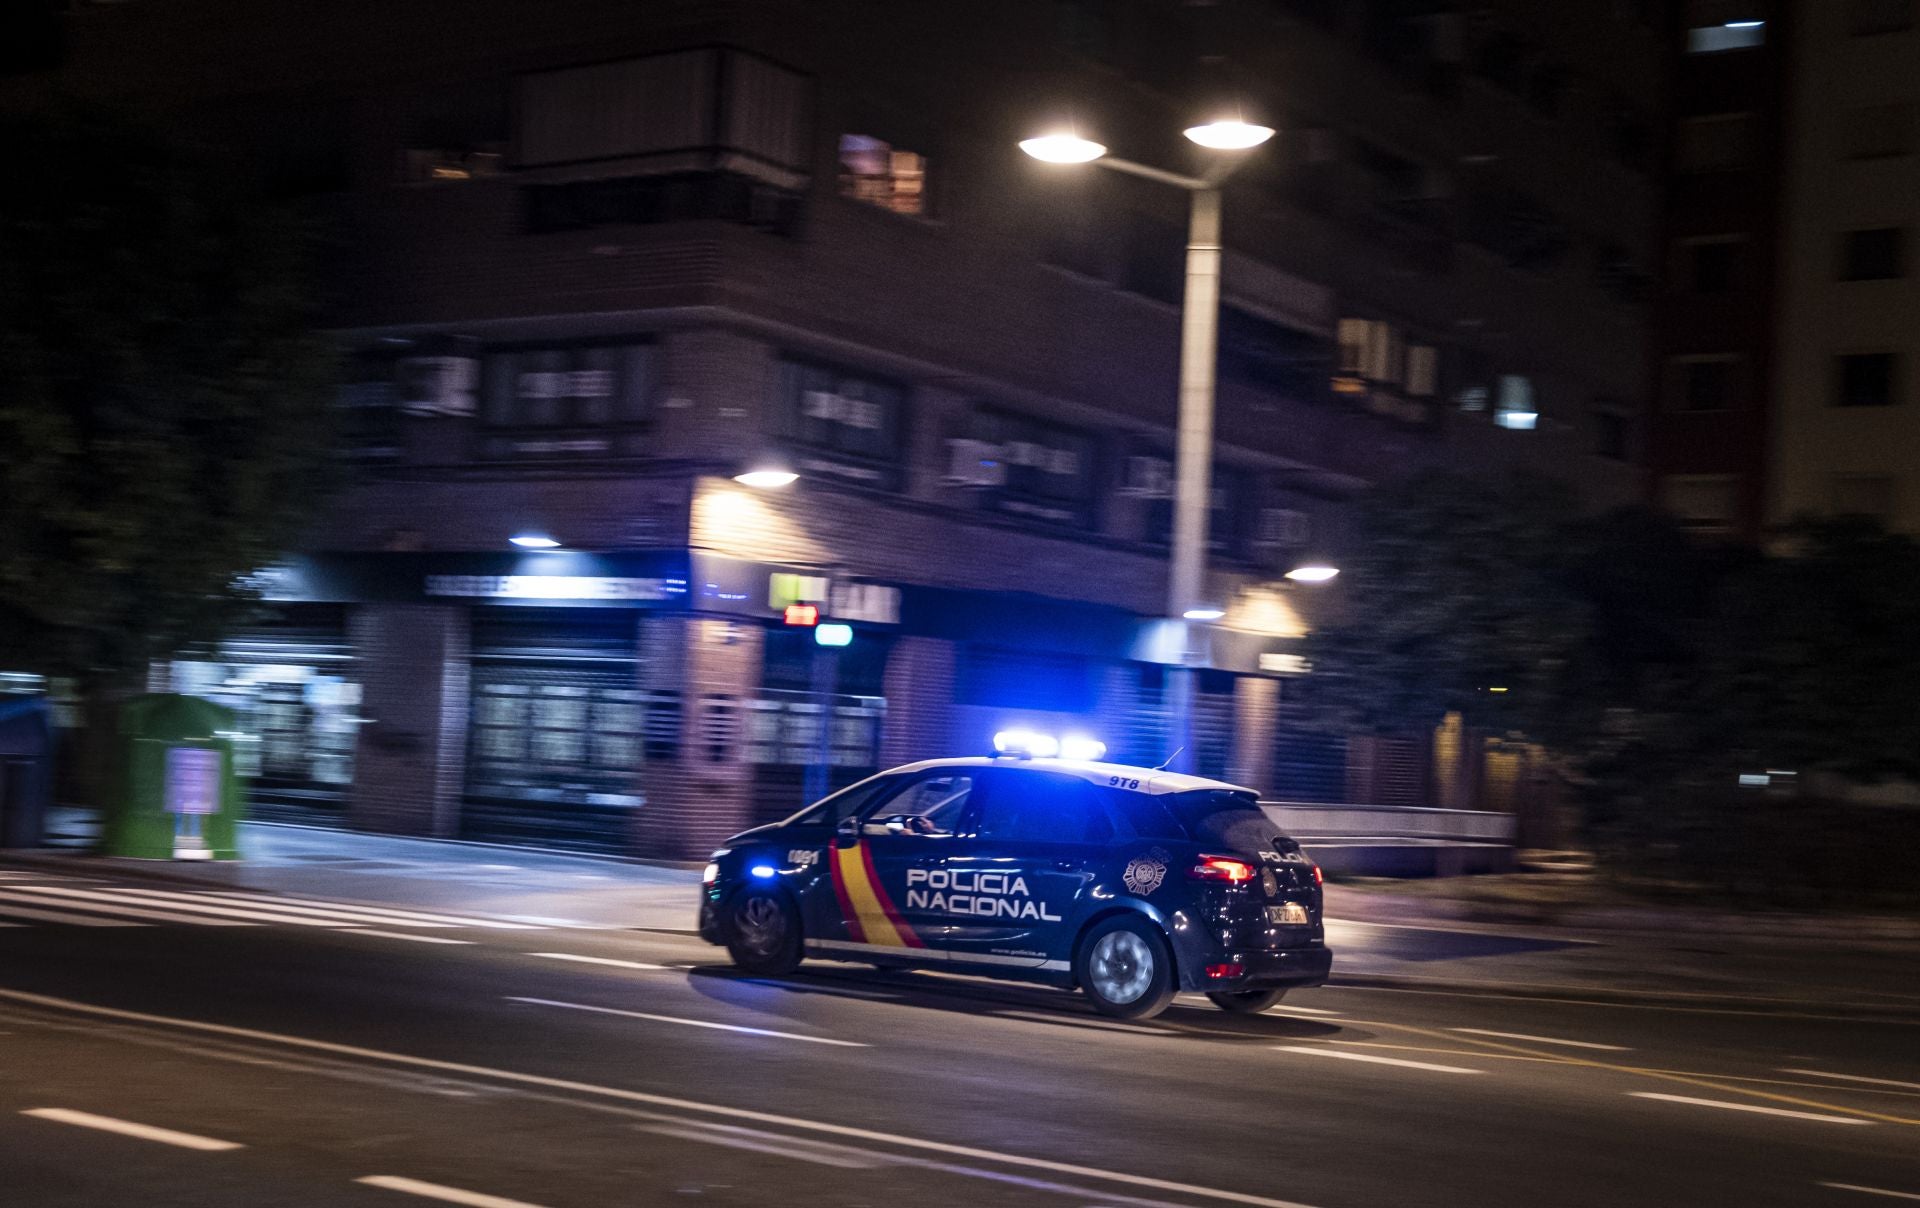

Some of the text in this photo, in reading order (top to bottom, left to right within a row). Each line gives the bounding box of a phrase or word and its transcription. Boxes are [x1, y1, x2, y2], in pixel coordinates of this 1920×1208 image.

[1109, 776, 1140, 790] 9T8
[906, 868, 1030, 896] POLICIA
[906, 889, 1062, 922] NACIONAL
